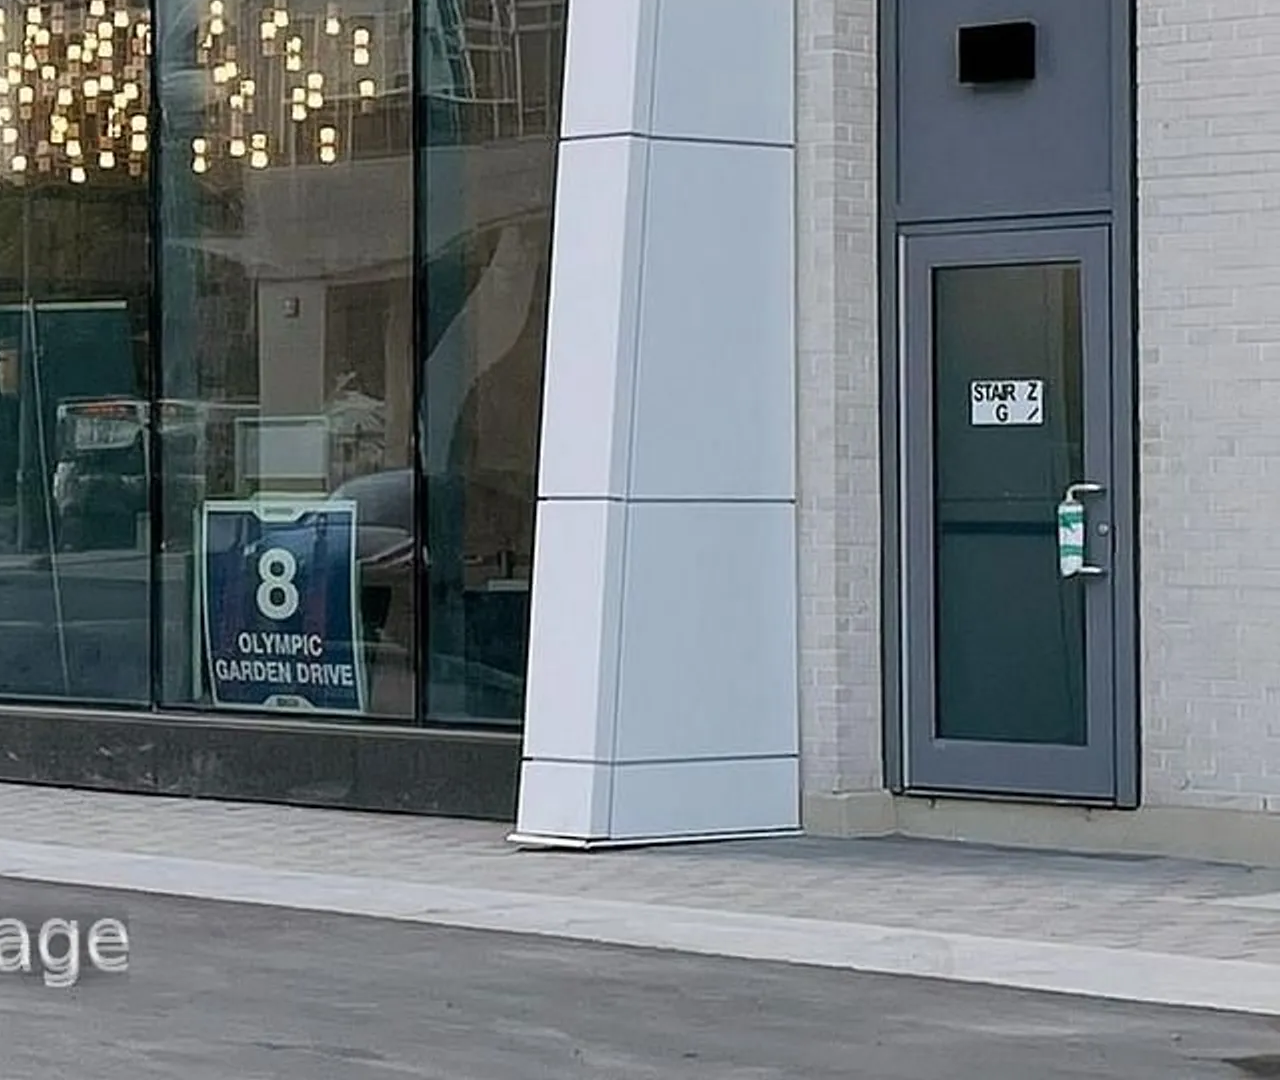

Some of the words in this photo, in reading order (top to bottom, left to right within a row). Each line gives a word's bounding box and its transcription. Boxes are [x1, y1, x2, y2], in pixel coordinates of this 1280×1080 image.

[974, 383, 1016, 402] STAIR
[1028, 382, 1038, 401] Z
[996, 404, 1009, 422] G
[256, 547, 299, 620] 8
[238, 632, 323, 656] OLYMPIC
[215, 659, 291, 684] GARDEN
[297, 662, 354, 686] DRIVE
